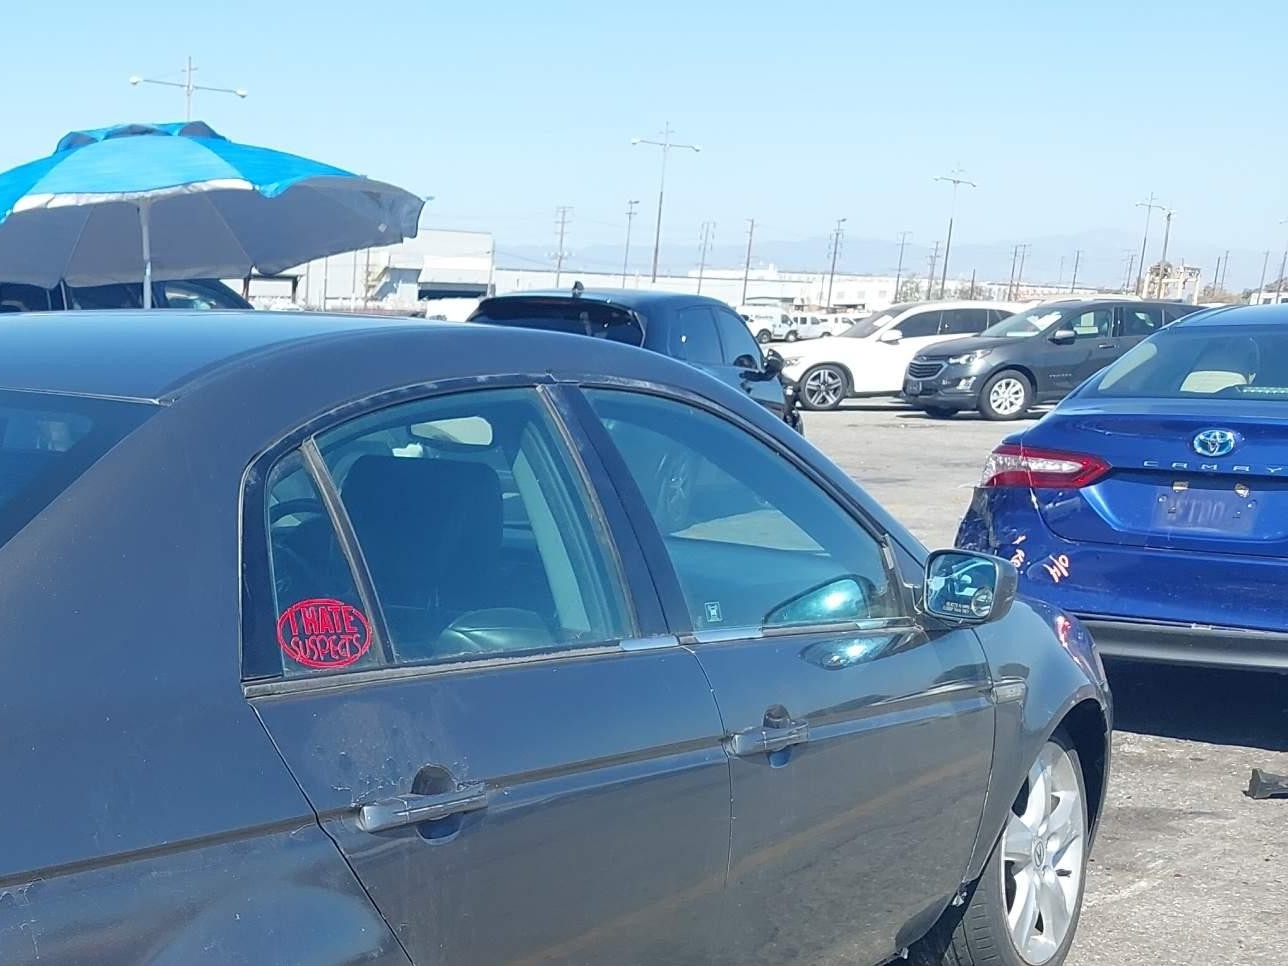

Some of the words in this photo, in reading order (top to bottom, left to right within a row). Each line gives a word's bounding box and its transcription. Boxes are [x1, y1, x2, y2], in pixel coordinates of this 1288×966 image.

[1143, 460, 1283, 473] CAMRY
[301, 606, 358, 634] HATE
[290, 635, 362, 660] SUSPECTS
